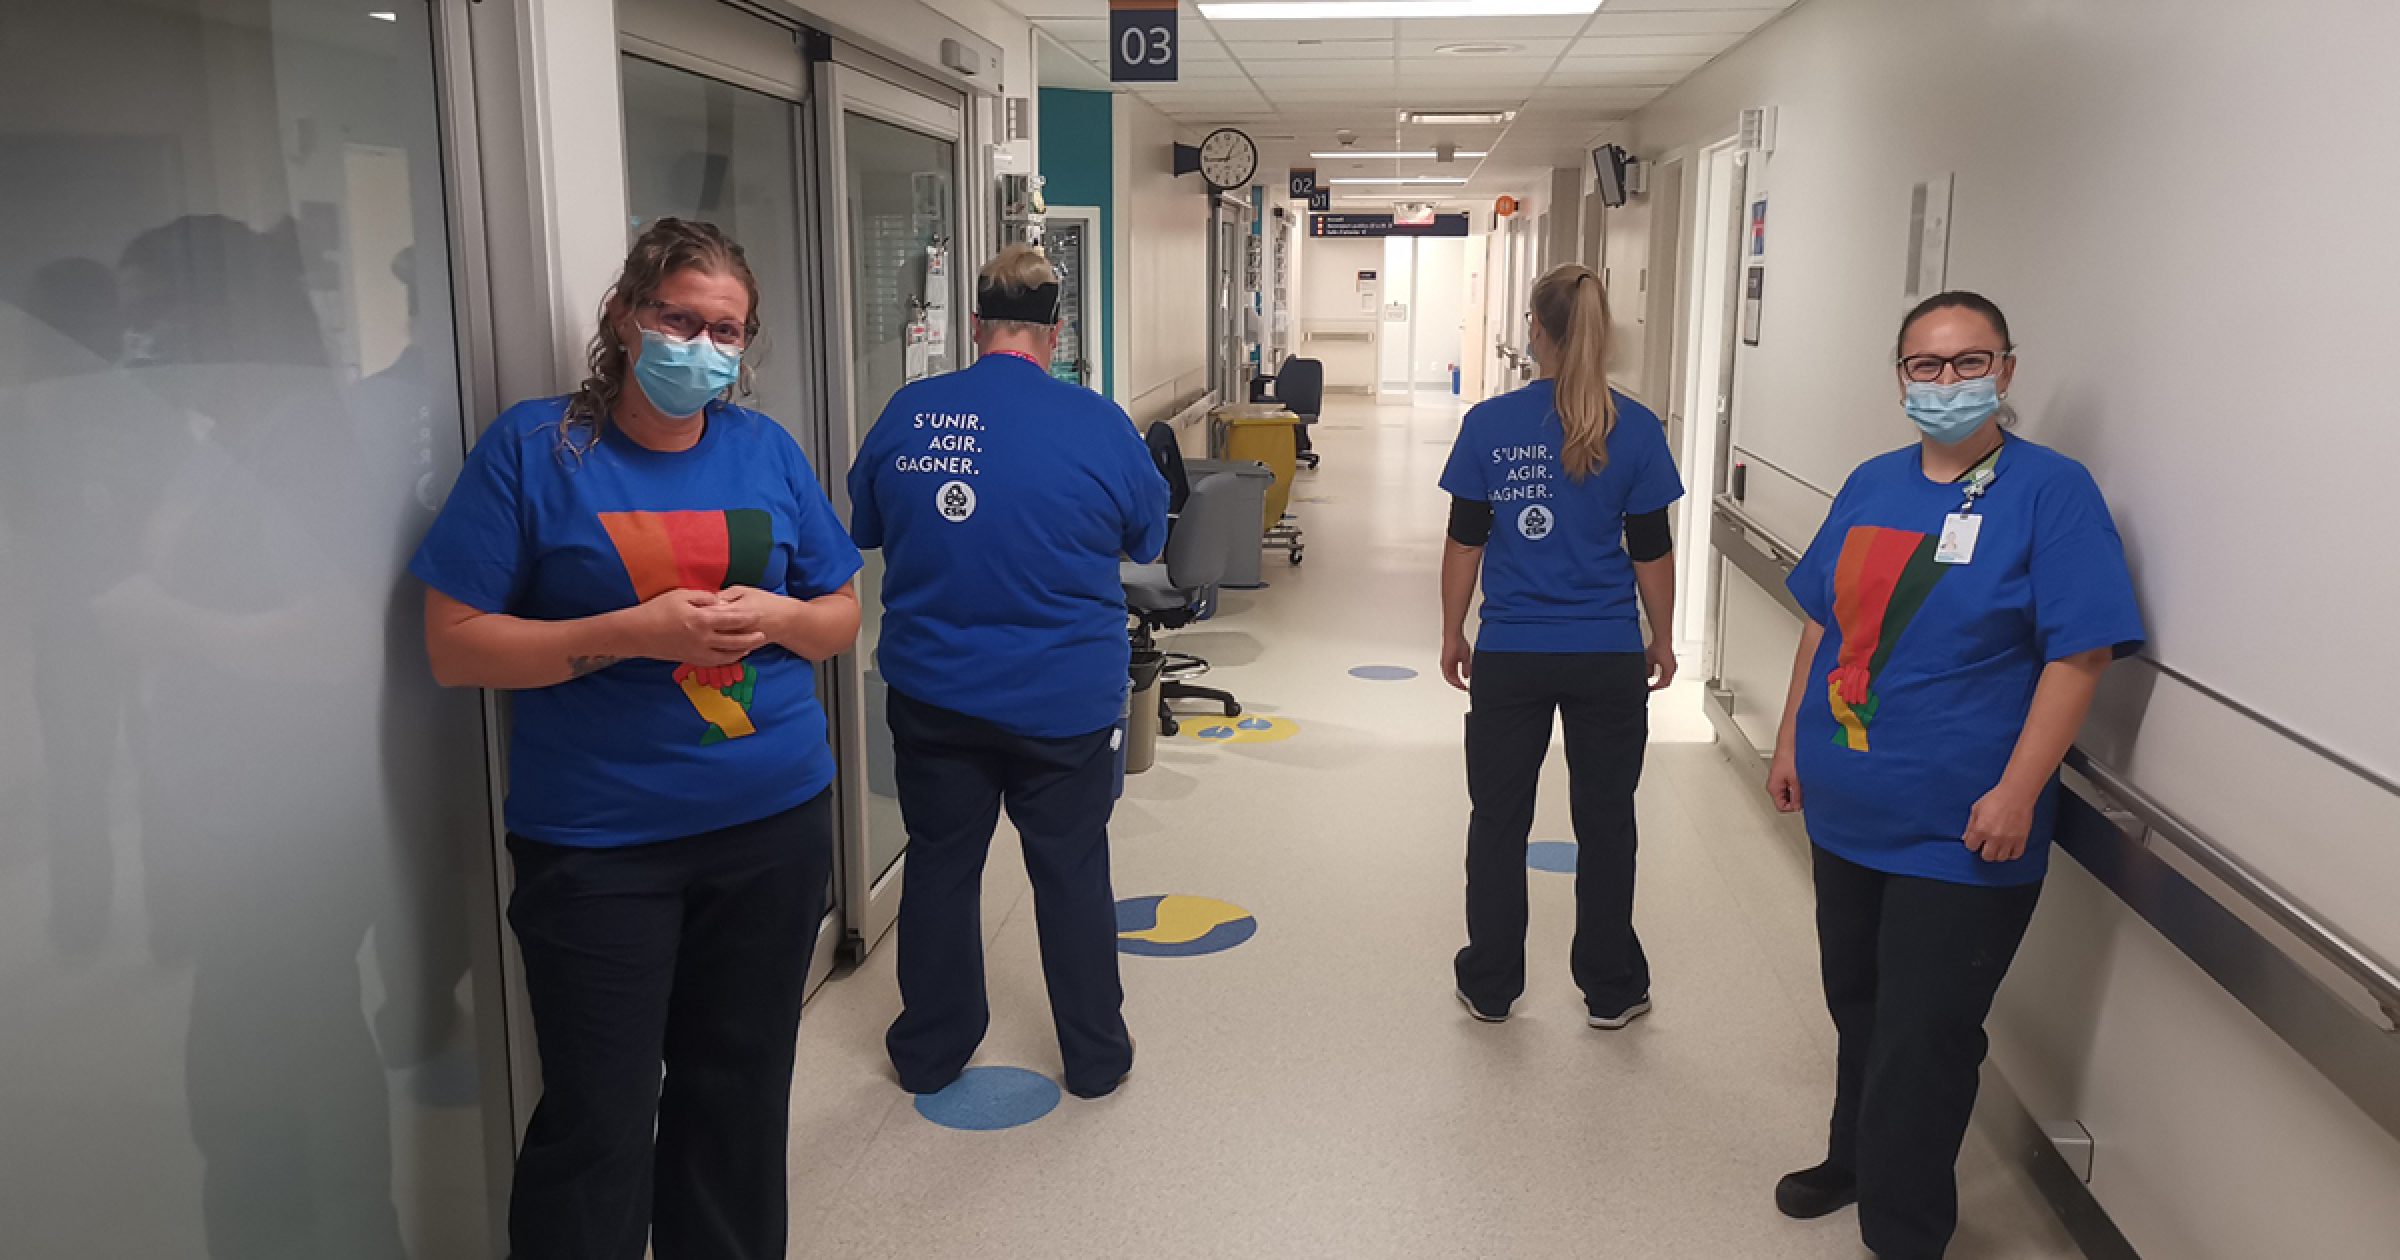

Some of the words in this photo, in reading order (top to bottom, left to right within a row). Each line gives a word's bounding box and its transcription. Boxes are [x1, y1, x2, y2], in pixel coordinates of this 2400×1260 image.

[1121, 27, 1172, 65] 03
[1291, 178, 1312, 194] 02
[1312, 193, 1327, 207] 01
[913, 413, 985, 431] S'UNIR.
[928, 434, 982, 453] AGIR.
[1492, 444, 1553, 464] S'UNIR.
[895, 456, 979, 475] GAGNER.
[1506, 464, 1553, 481] AGIR.
